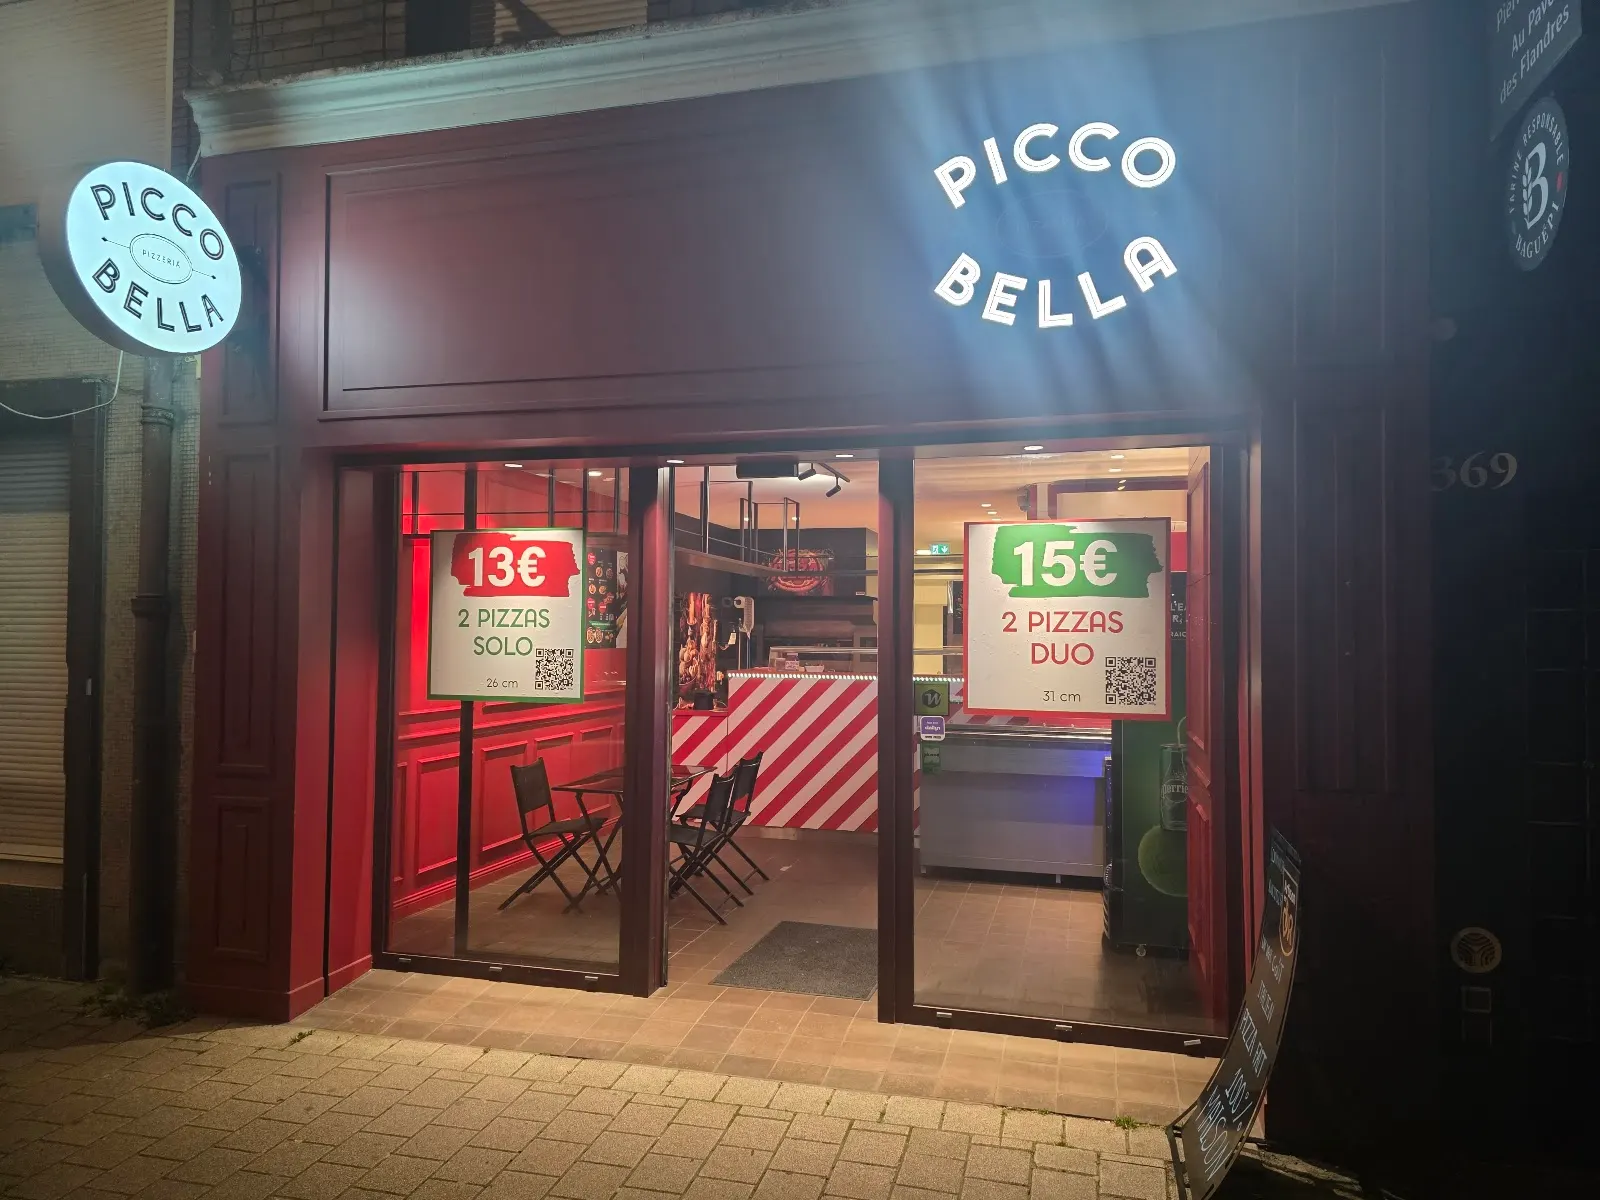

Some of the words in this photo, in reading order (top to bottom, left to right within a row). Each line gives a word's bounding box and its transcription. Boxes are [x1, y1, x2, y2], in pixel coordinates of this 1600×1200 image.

[1500, 73, 1517, 104] des
[1520, 4, 1569, 80] Flandres
[1511, 28, 1525, 58] Au
[1522, 112, 1564, 166] RESPONSABLE
[933, 121, 1176, 209] PICCO
[90, 181, 225, 261] PICCO
[141, 249, 181, 269] PIZZERIA
[91, 257, 225, 333] BELLA
[933, 236, 1178, 329] BELLA
[1430, 450, 1518, 492] 369
[468, 545, 547, 588] 13€
[1013, 540, 1118, 587] 15€
[458, 608, 470, 628] 2
[478, 608, 551, 629] PIZZAS
[1001, 611, 1018, 633] 2
[1028, 610, 1124, 634] PIZZAS
[473, 636, 533, 657] SOLO
[1031, 642, 1095, 666] DUO
[486, 678, 499, 689] 26
[502, 680, 519, 689] cm
[1043, 690, 1055, 702] 31
[1060, 692, 1081, 702] cm
[1224, 1067, 1253, 1132] 100%
[1195, 1085, 1234, 1182] MAISON
